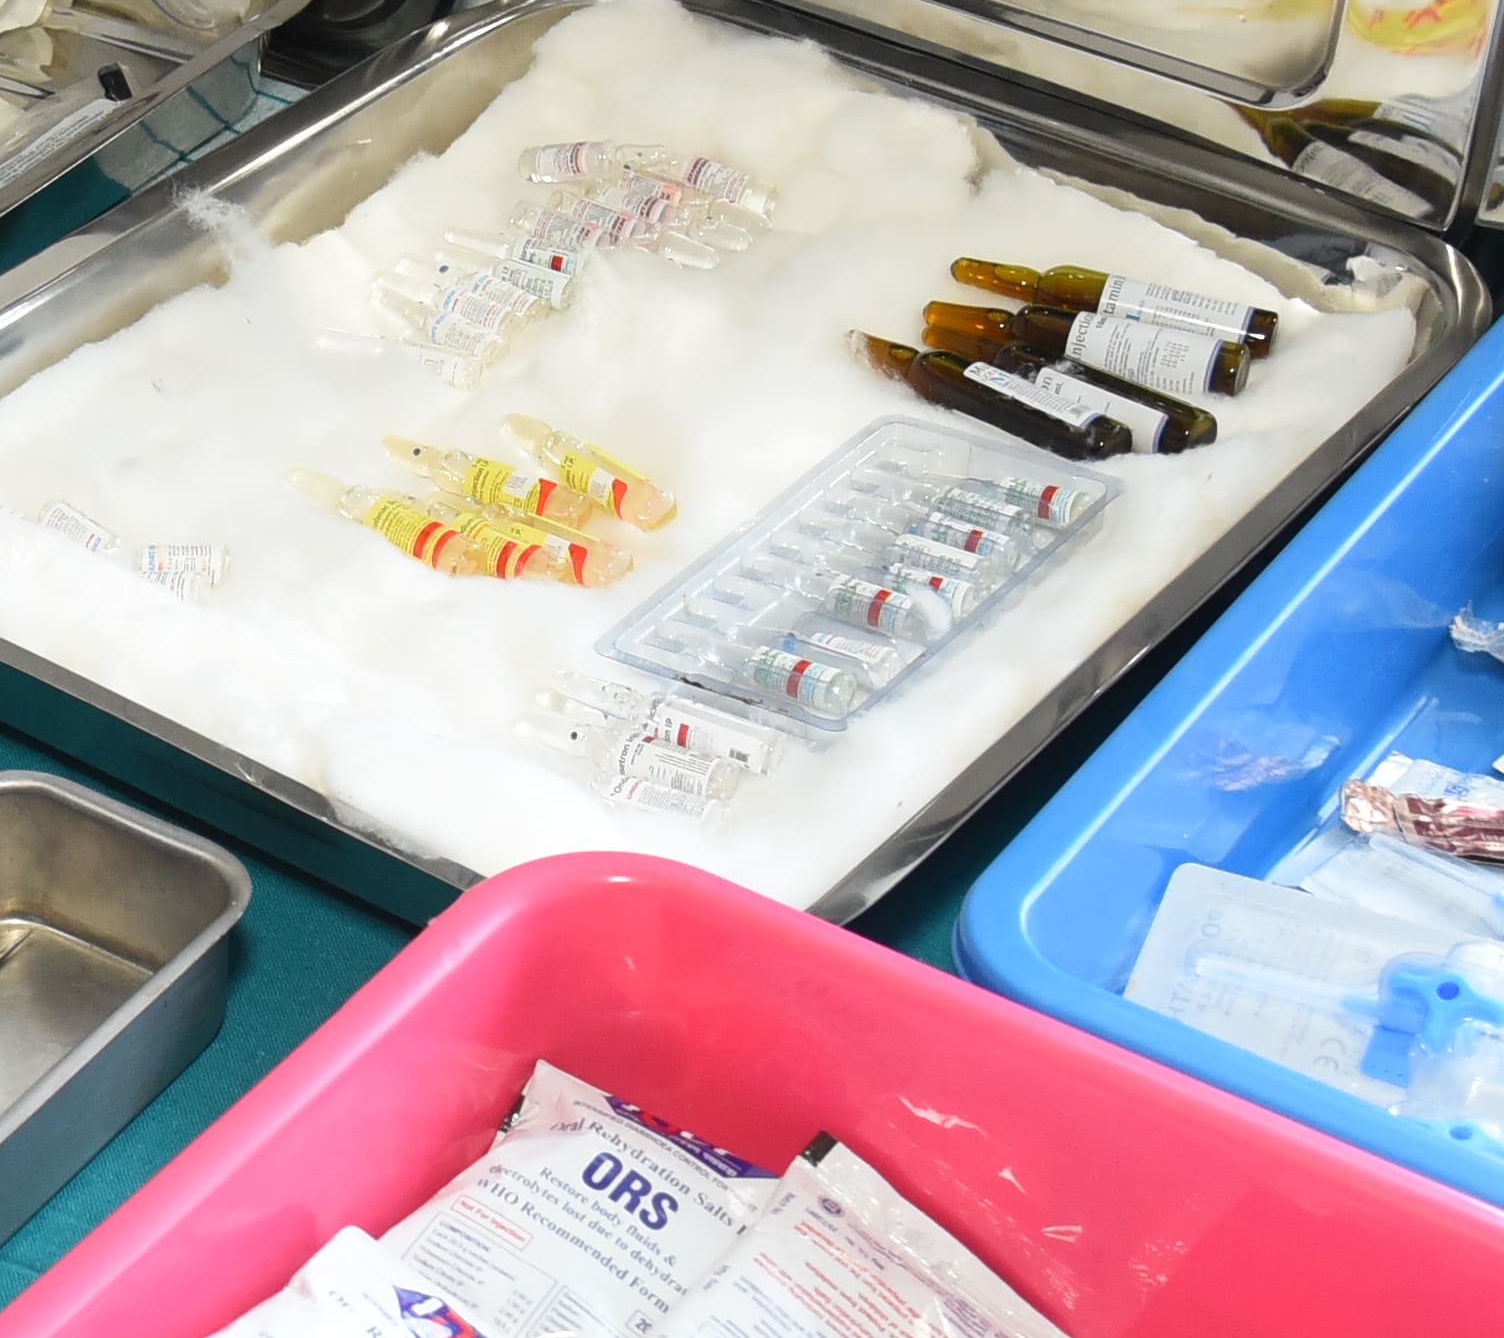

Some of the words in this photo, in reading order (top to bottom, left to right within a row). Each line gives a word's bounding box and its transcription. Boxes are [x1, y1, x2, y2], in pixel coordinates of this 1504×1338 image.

[536, 1163, 591, 1208] Restore
[587, 1196, 626, 1232] body
[621, 1220, 667, 1260] fluids
[576, 1143, 683, 1238] ORS
[580, 1118, 694, 1199] Rehydration
[690, 1187, 738, 1230] Salts
[517, 1198, 632, 1283] Recommended
[626, 1273, 674, 1315] Form
[625, 1245, 692, 1301] dehydrat
